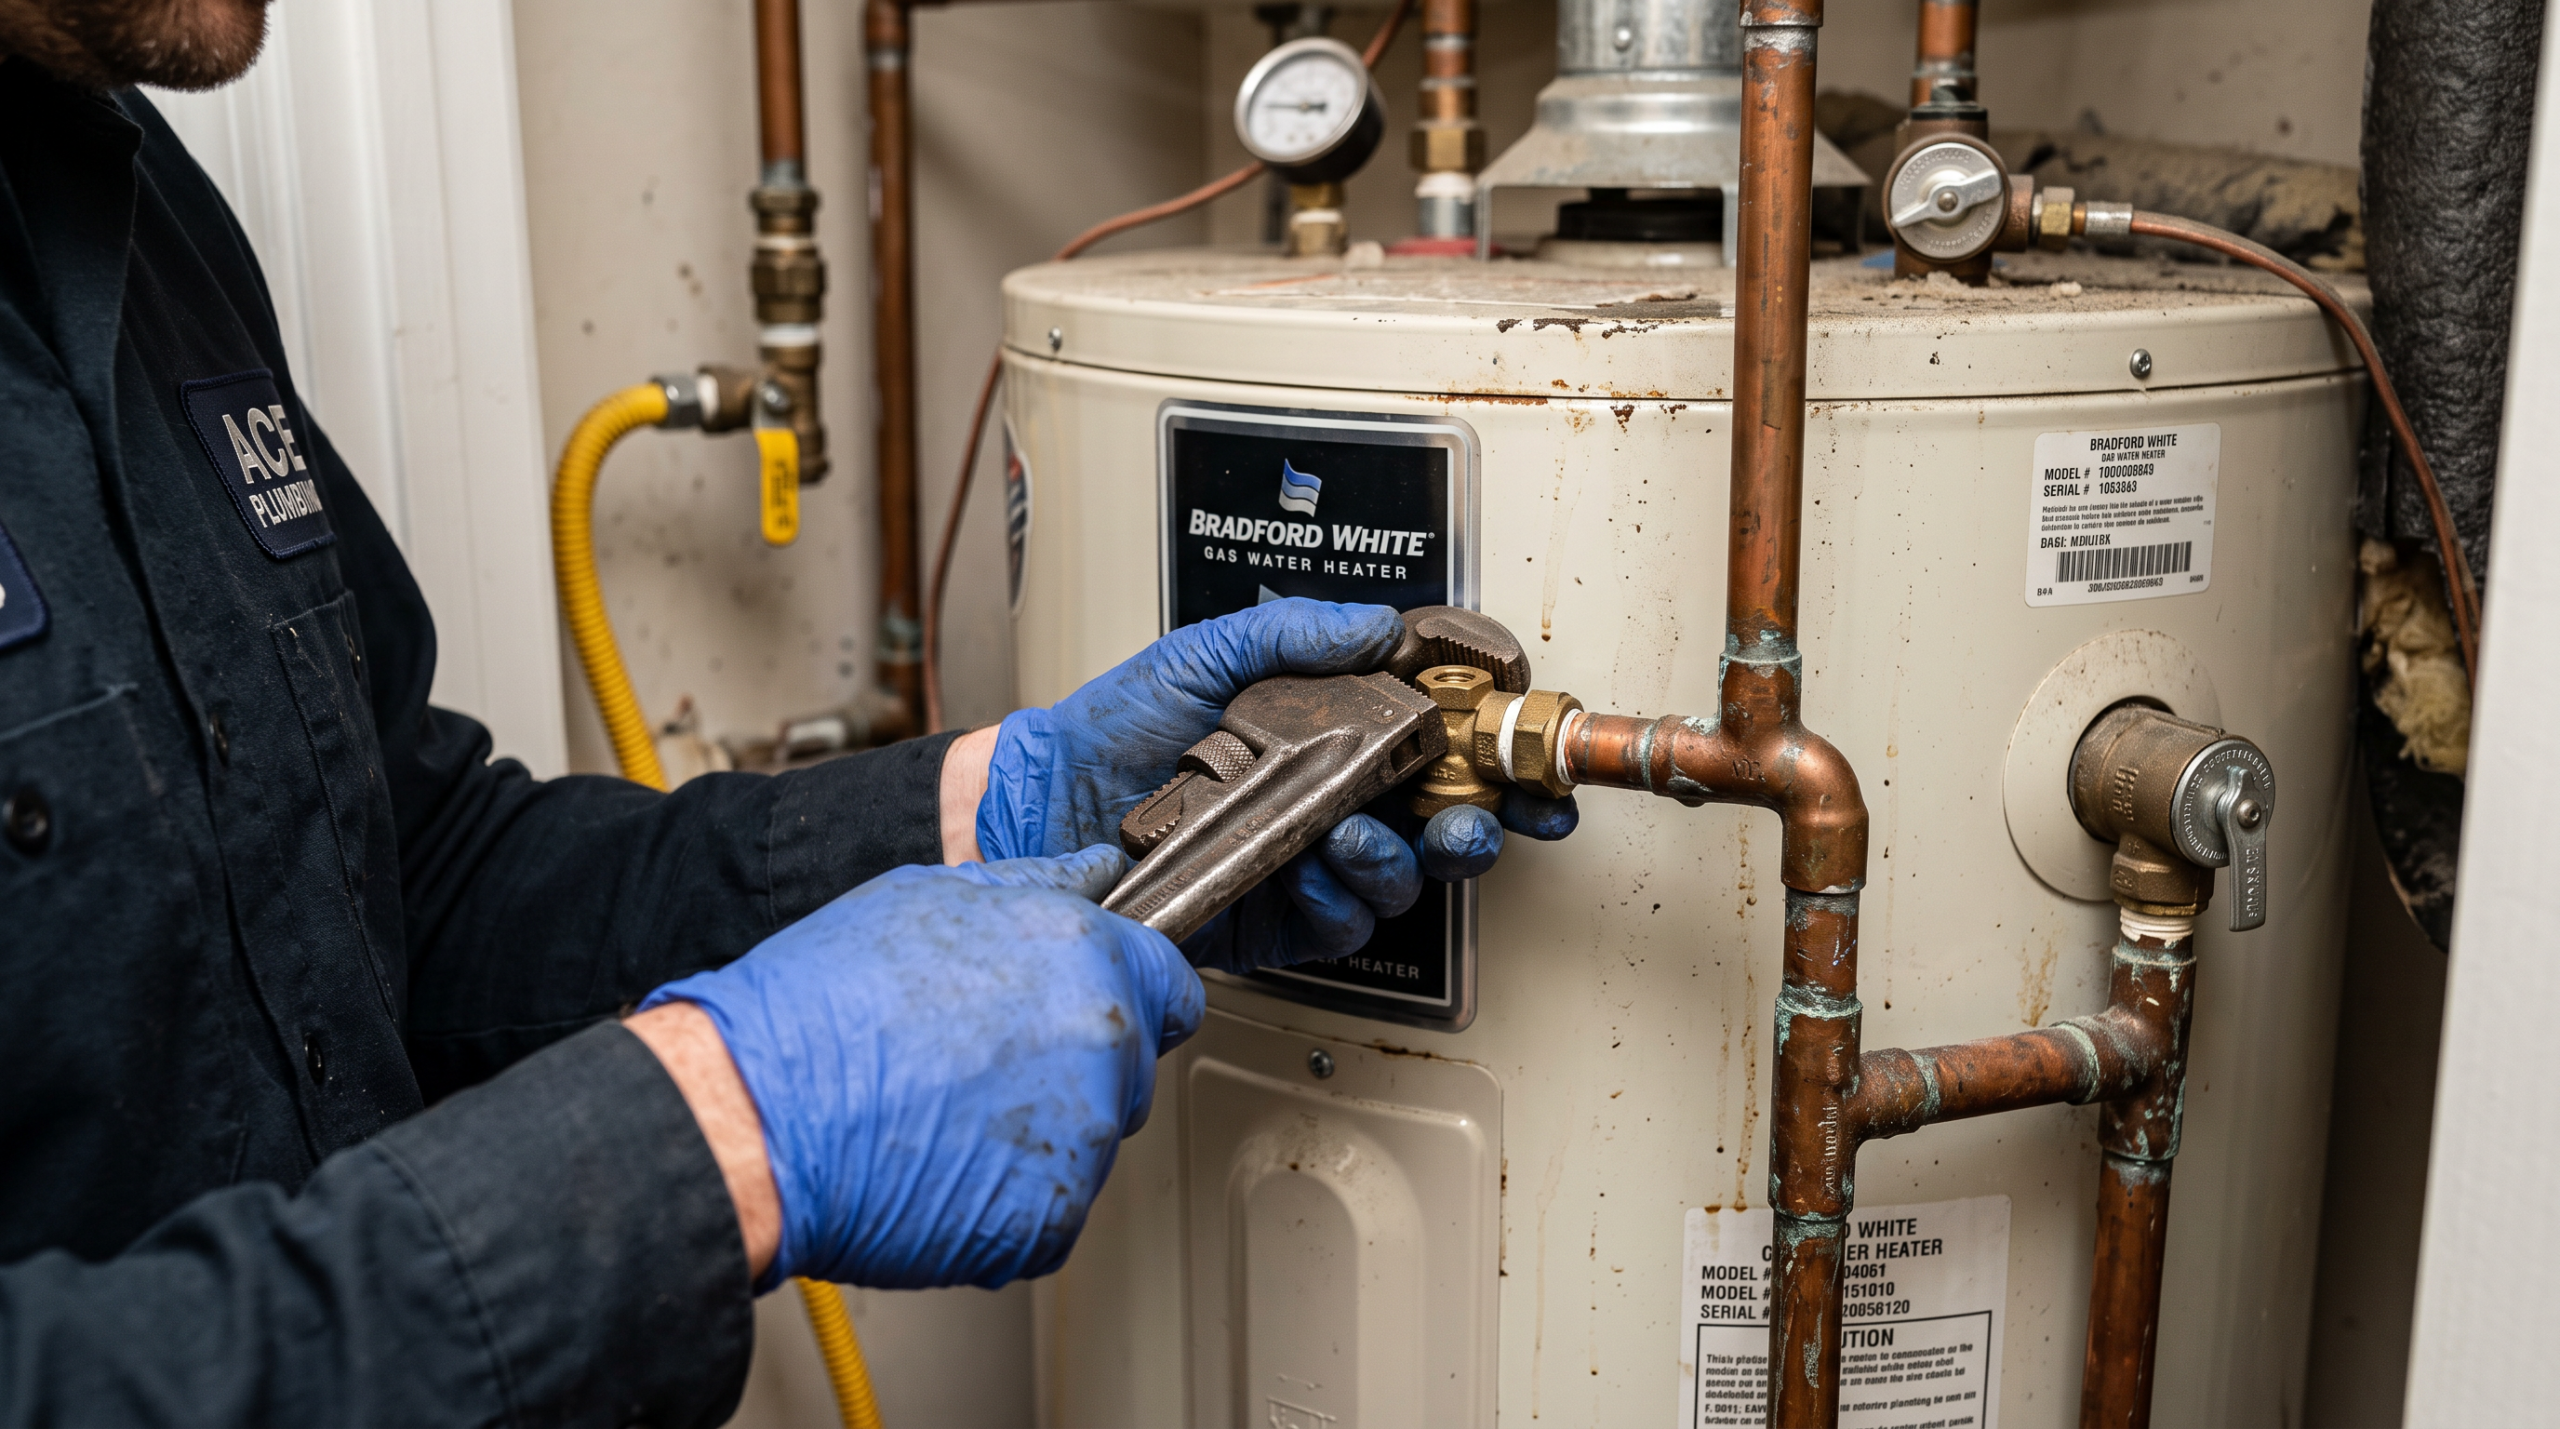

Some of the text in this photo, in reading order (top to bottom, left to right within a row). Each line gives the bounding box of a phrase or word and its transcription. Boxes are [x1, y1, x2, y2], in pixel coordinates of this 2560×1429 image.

[222, 404, 307, 484] ACE
[2090, 433, 2178, 451] BRADFORD WHITE
[2044, 467, 2081, 480] MODEL
[2084, 467, 2091, 479] #
[2043, 483, 2080, 497] SERIAL
[2083, 484, 2090, 495] #
[1188, 508, 1323, 549] BRADFORD
[1204, 545, 1408, 580] GAS WATER HEATER
[1348, 956, 1420, 980] HEATER
[1858, 1218, 1918, 1239] WHITE
[1875, 1238, 1943, 1259] HEATER
[1701, 1265, 1758, 1281] MODEL
[1762, 1267, 1771, 1280] #
[1701, 1285, 1757, 1300] MODEL
[1762, 1286, 1771, 1300] #
[1700, 1304, 1756, 1320] SERIAL
[1762, 1306, 1770, 1319] #
